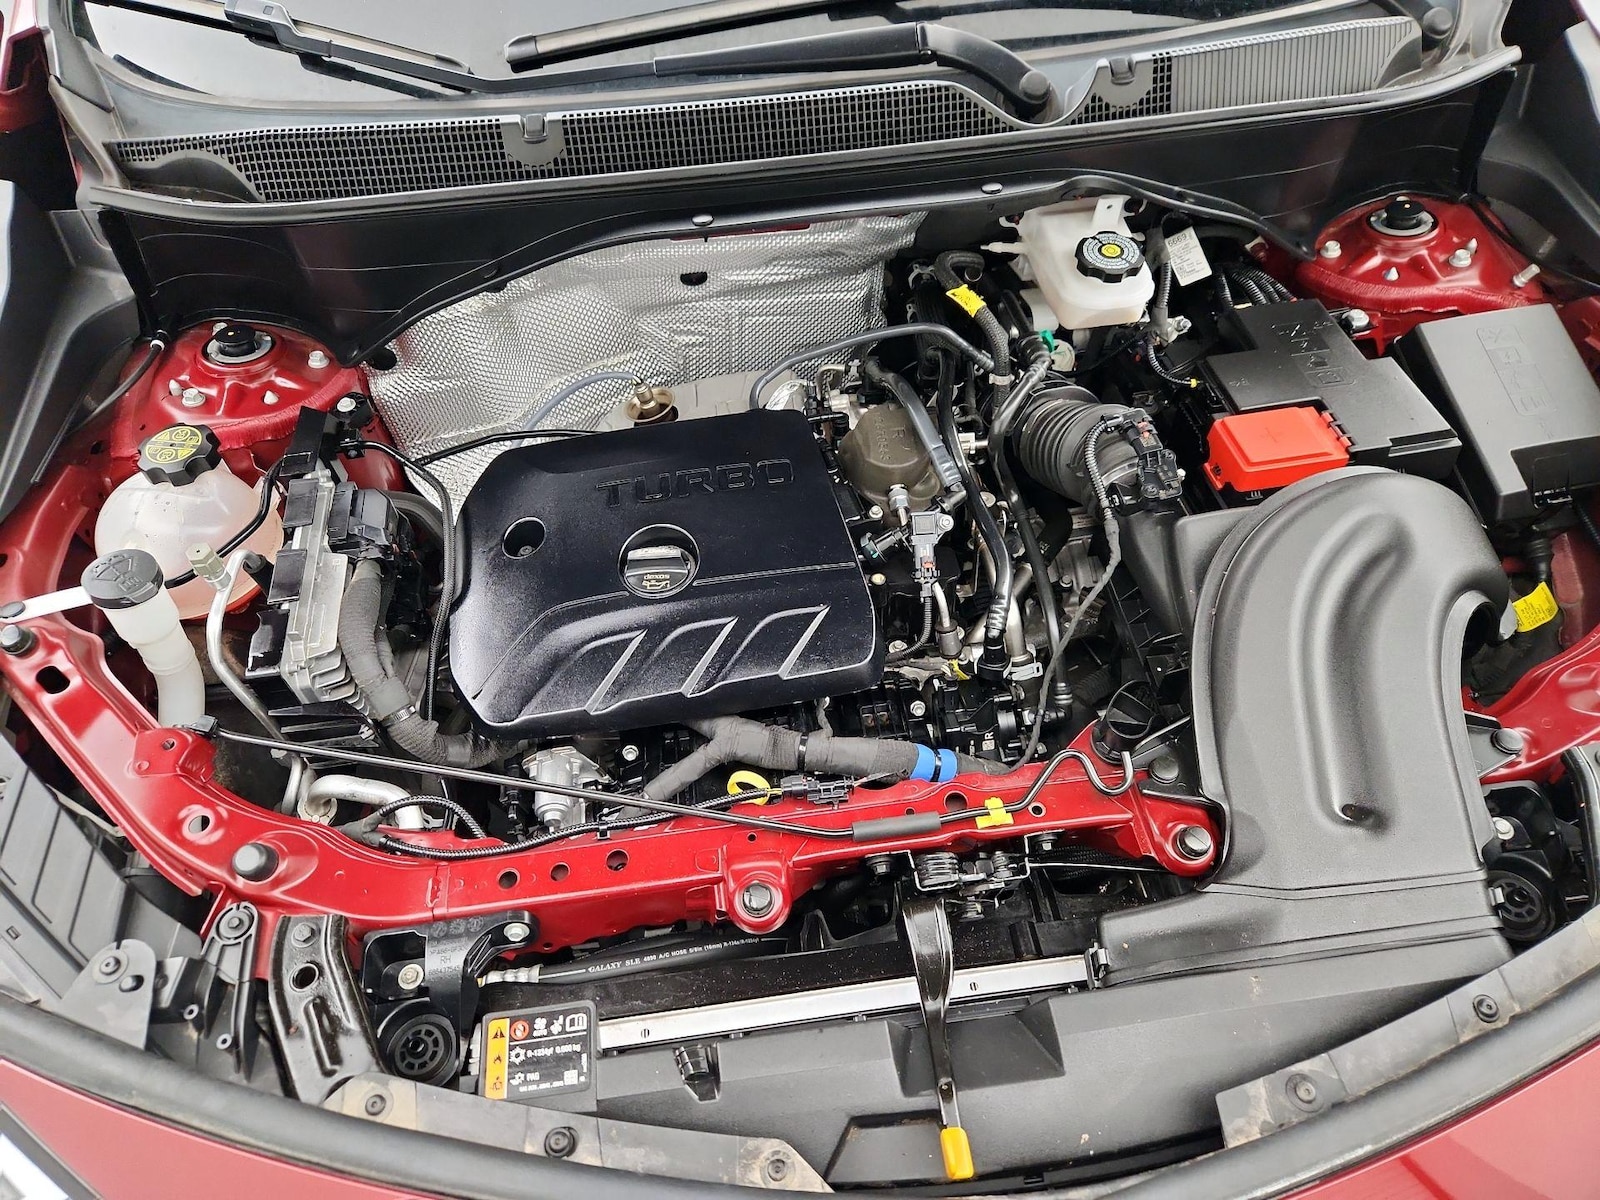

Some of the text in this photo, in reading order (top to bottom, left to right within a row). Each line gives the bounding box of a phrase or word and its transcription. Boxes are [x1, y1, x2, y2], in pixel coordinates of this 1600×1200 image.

[596, 459, 794, 508] TURBO
[441, 955, 452, 963] RH
[589, 961, 622, 973] GALAXY
[625, 958, 641, 967] SLE
[658, 951, 670, 959] A/C
[671, 949, 687, 957] HOSE
